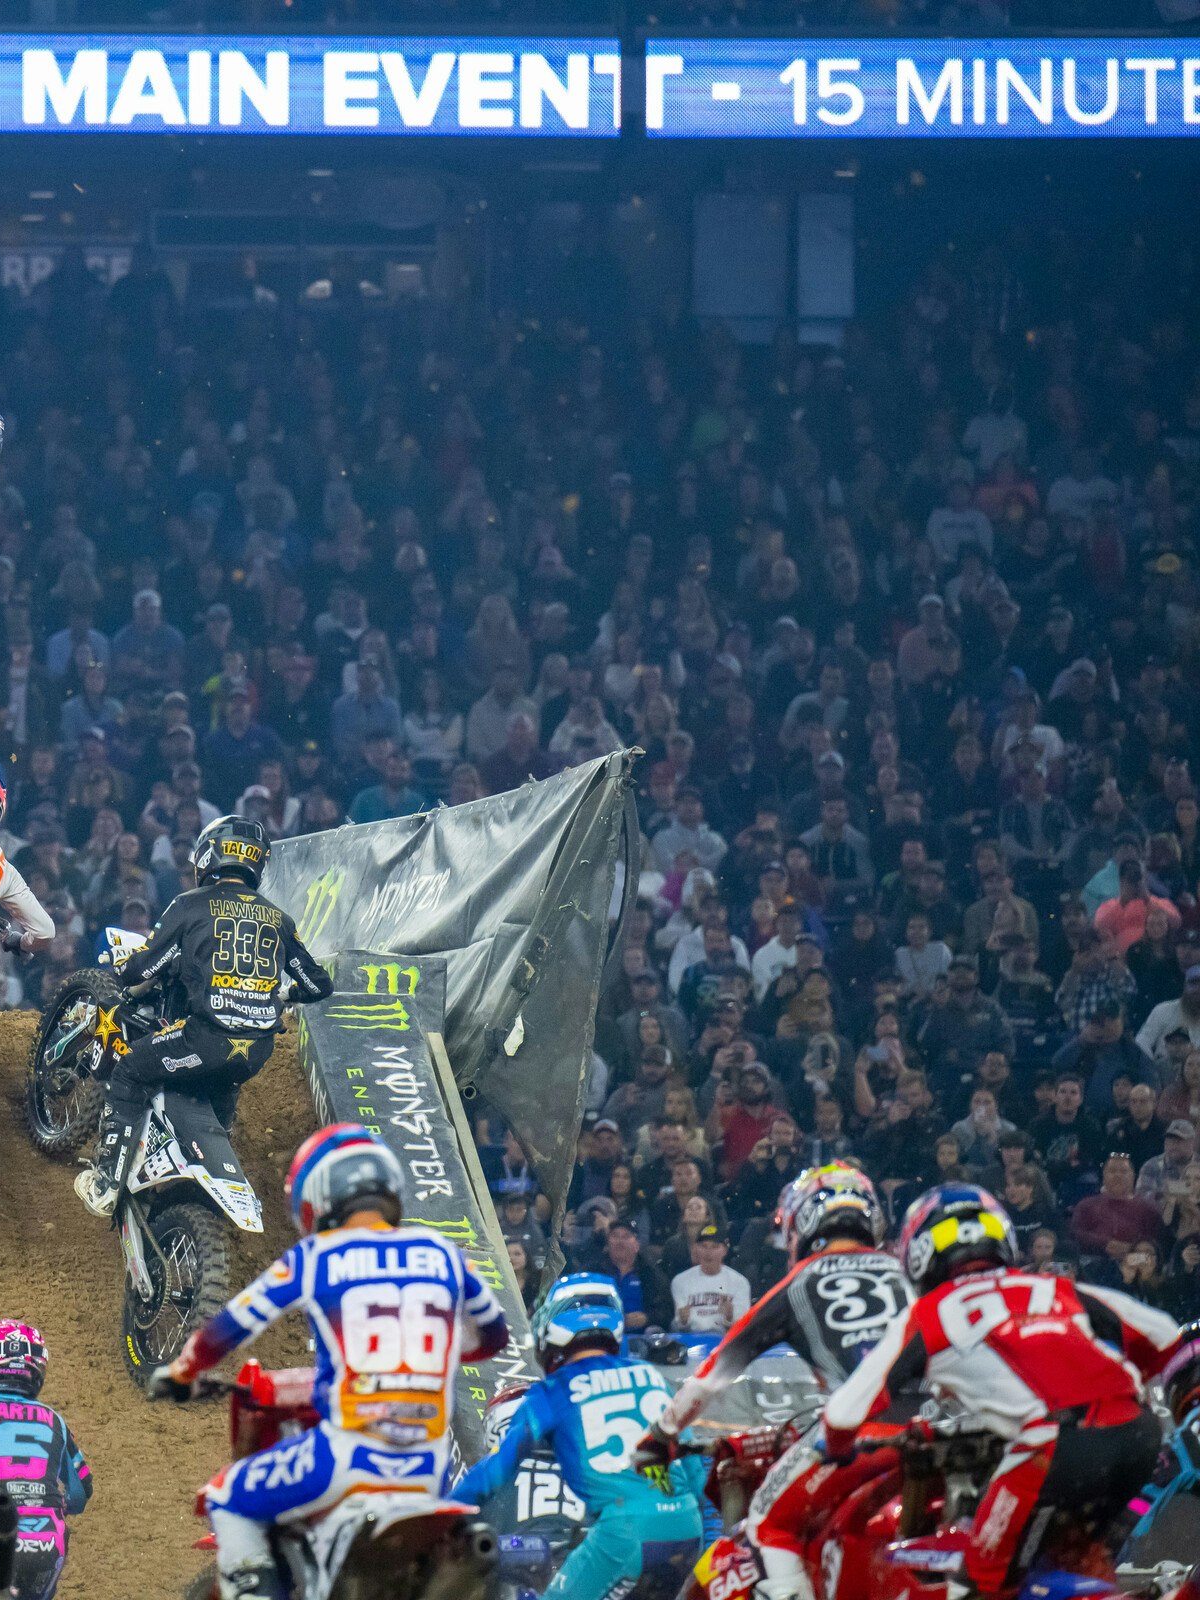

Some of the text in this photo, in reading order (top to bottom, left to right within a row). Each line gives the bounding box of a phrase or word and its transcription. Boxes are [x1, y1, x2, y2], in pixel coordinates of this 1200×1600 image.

[22, 49, 289, 127] MAIN
[322, 52, 684, 129] EVENT
[779, 58, 866, 126] 15
[221, 840, 262, 861] TALON
[209, 899, 283, 929] HAWKINS
[212, 917, 280, 980] 339
[218, 988, 272, 1001] ENERGY DRINK
[224, 996, 277, 1016] Husqvarna
[346, 1067, 382, 1136] ENER
[210, 1186, 236, 1214] DUNLOP
[327, 1246, 449, 1287] MILLER
[341, 1281, 453, 1374] 66
[936, 1275, 1057, 1349] 67
[568, 1364, 667, 1404] SMITH
